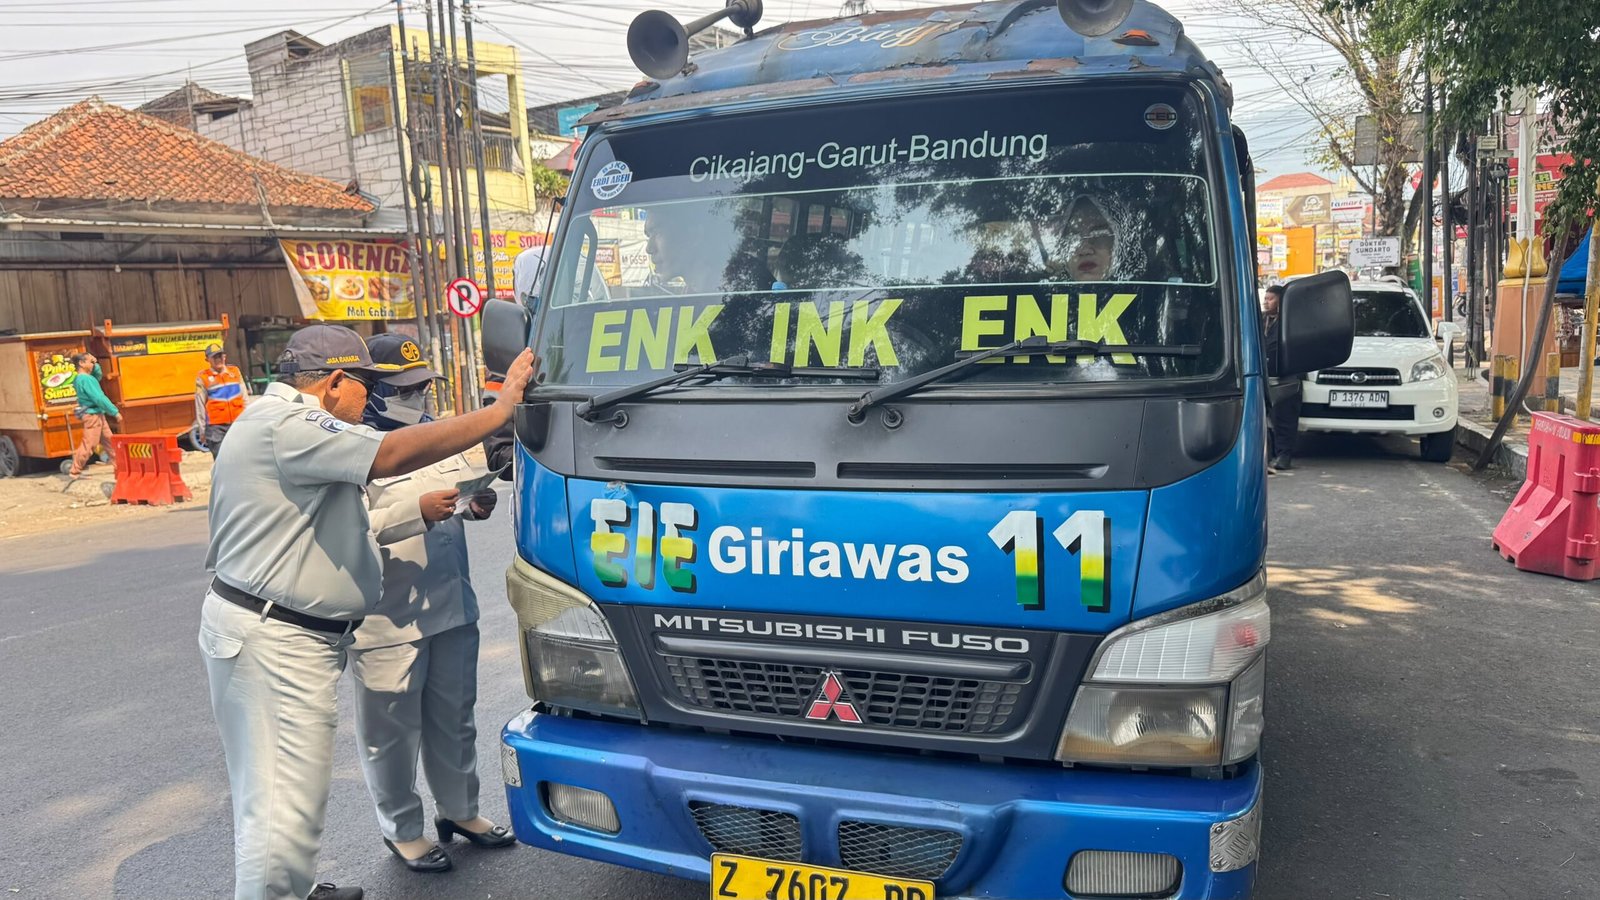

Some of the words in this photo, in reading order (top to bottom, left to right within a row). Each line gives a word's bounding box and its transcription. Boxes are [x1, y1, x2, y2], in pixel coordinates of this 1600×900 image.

[689, 130, 1048, 182] Cikajang-Garut-Bandung
[296, 241, 412, 274] GORENGA
[487, 233, 506, 248] ASI
[457, 285, 471, 311] P
[586, 304, 725, 373] ENK
[770, 299, 904, 368] INK
[960, 294, 1137, 364] ENK
[1332, 392, 1338, 402] D
[708, 525, 970, 584] Giriawas
[987, 510, 1111, 613] 11
[654, 613, 885, 643] MITSUBISHI
[902, 630, 1029, 654] FUSO
[718, 860, 738, 898] Z
